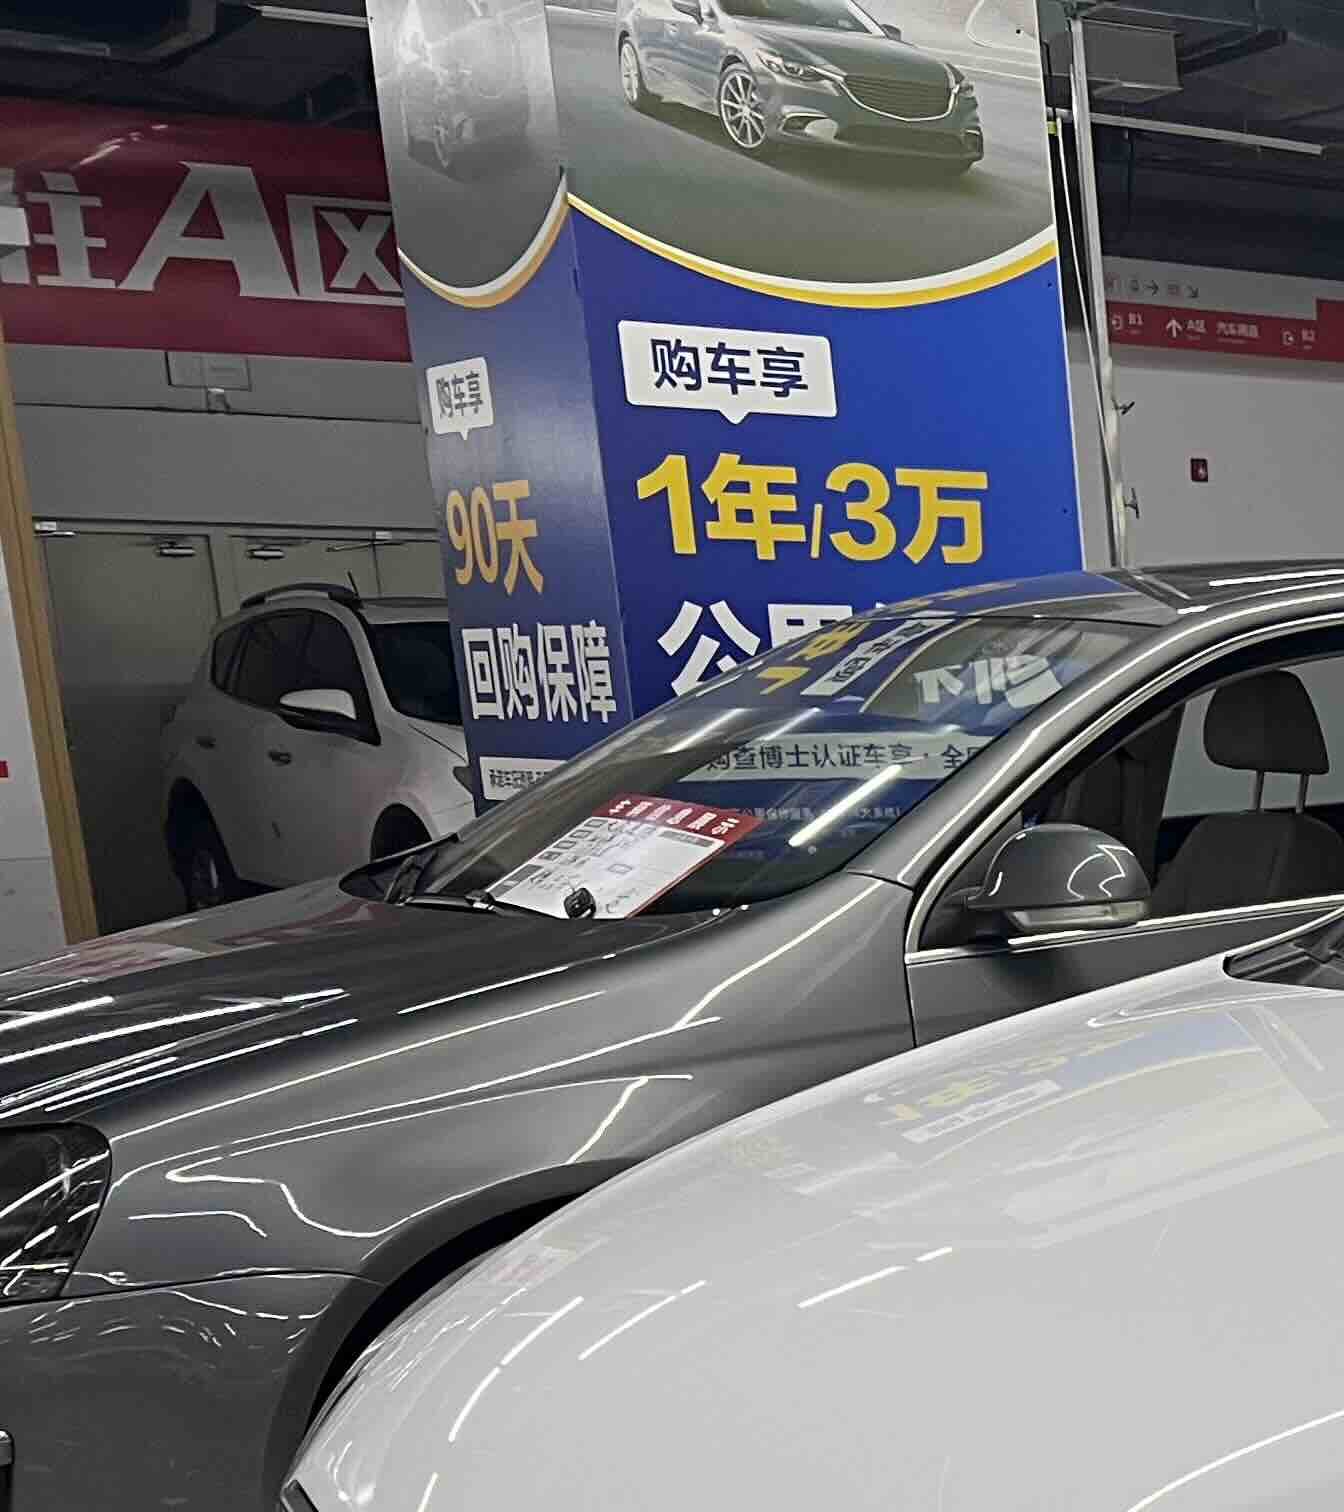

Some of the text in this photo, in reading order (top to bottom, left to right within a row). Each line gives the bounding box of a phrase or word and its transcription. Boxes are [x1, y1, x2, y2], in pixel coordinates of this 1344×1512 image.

[435, 370, 484, 420] 购车享
[650, 338, 809, 398] 购车享
[445, 479, 545, 596] 90天
[635, 451, 989, 565] 1年/3万
[461, 618, 617, 724] 回购保障
